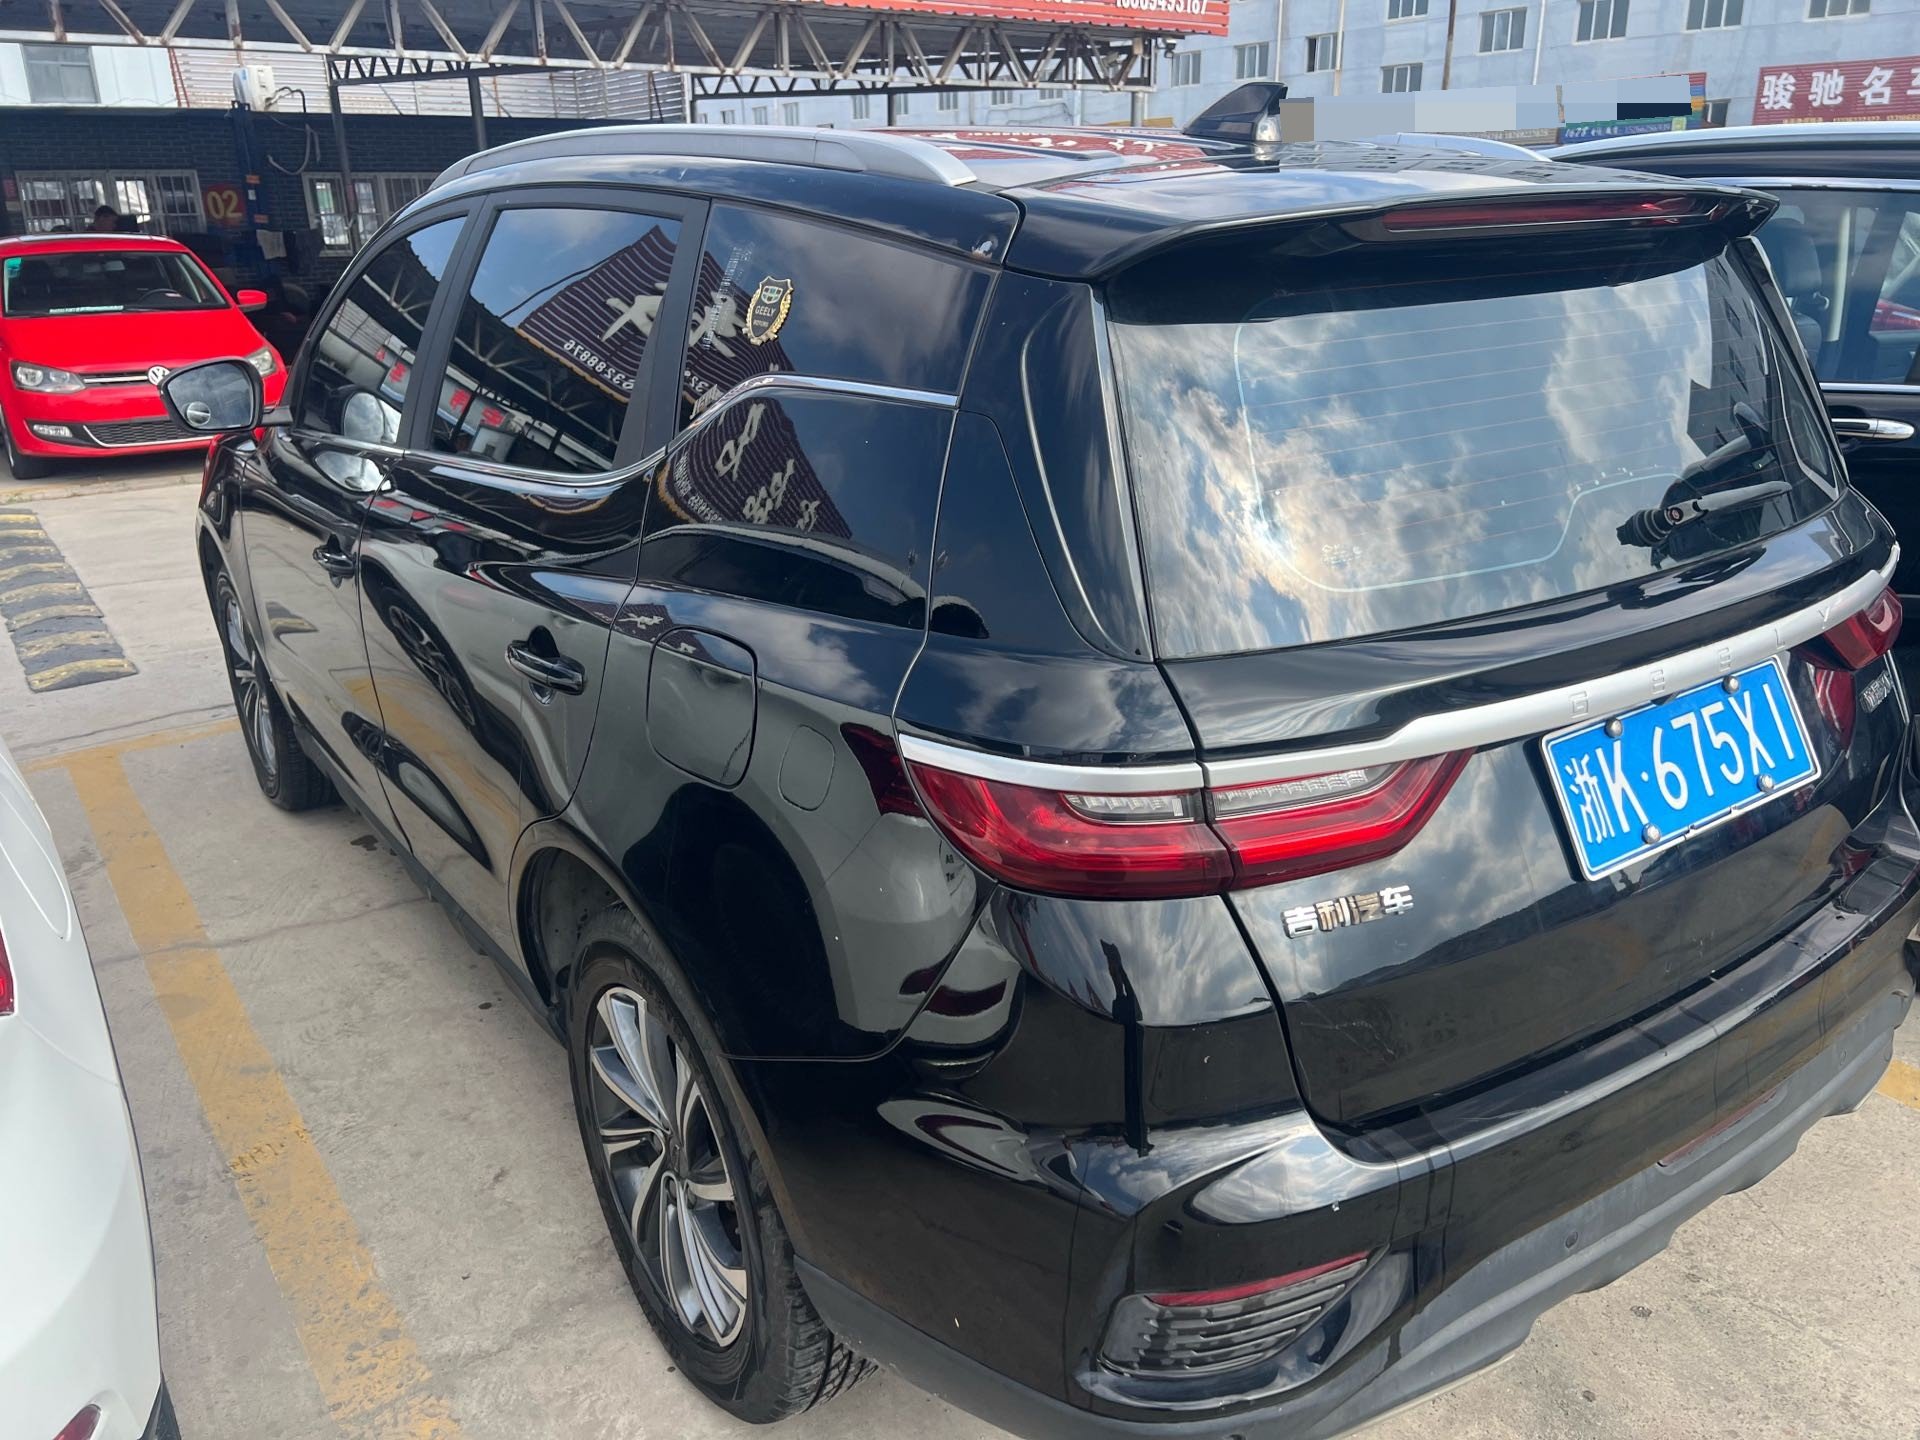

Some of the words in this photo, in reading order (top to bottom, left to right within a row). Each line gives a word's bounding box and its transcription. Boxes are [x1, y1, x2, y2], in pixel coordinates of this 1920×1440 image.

[207, 190, 242, 219] 02
[755, 306, 776, 317] GEELY
[1568, 604, 1833, 720] GEELY
[1280, 885, 1414, 939] 吉利汽车
